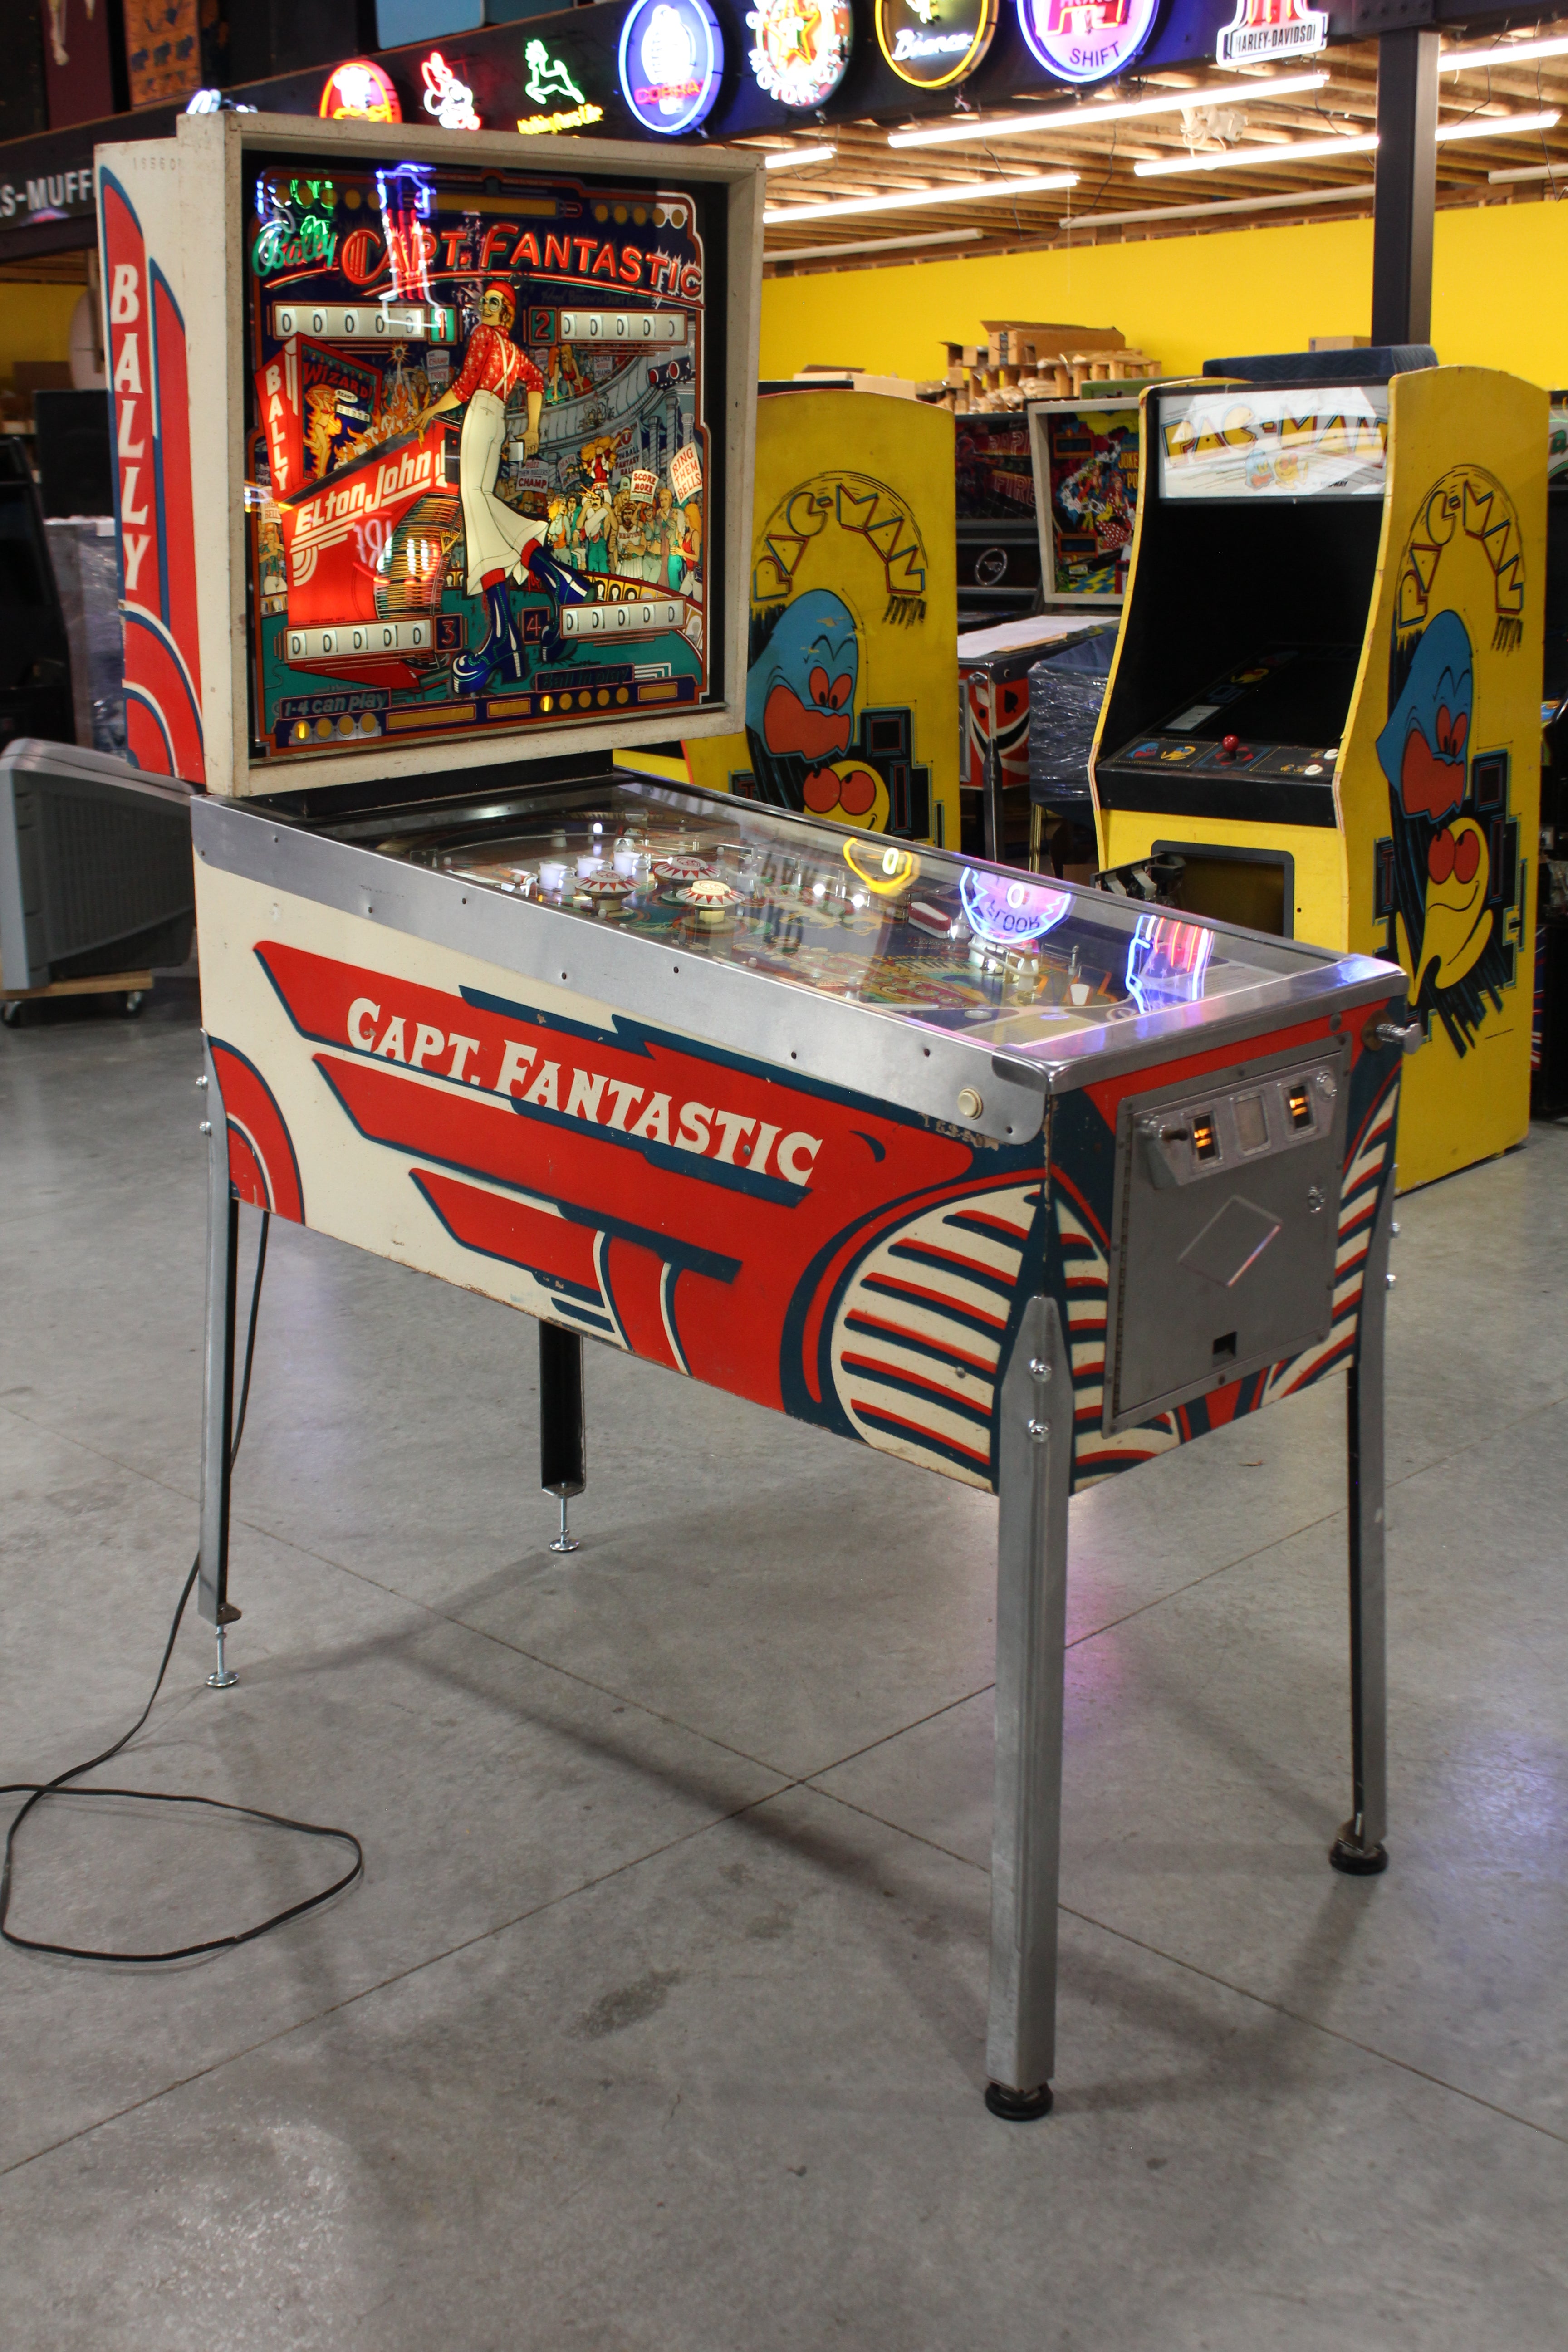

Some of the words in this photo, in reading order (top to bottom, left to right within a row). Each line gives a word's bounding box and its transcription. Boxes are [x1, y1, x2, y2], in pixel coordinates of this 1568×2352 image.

[1069, 41, 1119, 67] SHIFT
[0, 169, 97, 218] S-MUFF
[251, 215, 338, 276] Bally
[480, 223, 702, 297] FANTASTIC
[534, 310, 550, 339] 2
[302, 361, 373, 404] WIZARD!
[110, 264, 150, 591] BALLY
[265, 364, 289, 492] BALLY
[1160, 402, 1388, 468] PAC-MAN
[615, 456, 639, 469] FANTASY
[672, 447, 694, 475] RING
[675, 460, 698, 486] THEM
[1118, 451, 1139, 470] JOKE
[365, 450, 431, 513] John
[519, 477, 547, 489] CHAMP
[633, 473, 656, 485] SCORE
[634, 483, 653, 493] MORE
[677, 473, 702, 500] BELLS
[753, 483, 926, 603] PAC-MAN
[1399, 478, 1524, 628] PAC-MAN
[441, 619, 455, 645] 3
[526, 614, 541, 637] 4
[543, 671, 574, 689] Ball
[578, 670, 592, 686] in
[593, 667, 630, 689] play
[284, 701, 309, 716] 1-4
[312, 696, 346, 713] can
[349, 691, 387, 713] play
[347, 997, 481, 1083] CAPT.
[493, 1039, 823, 1187] FANTASTIC
